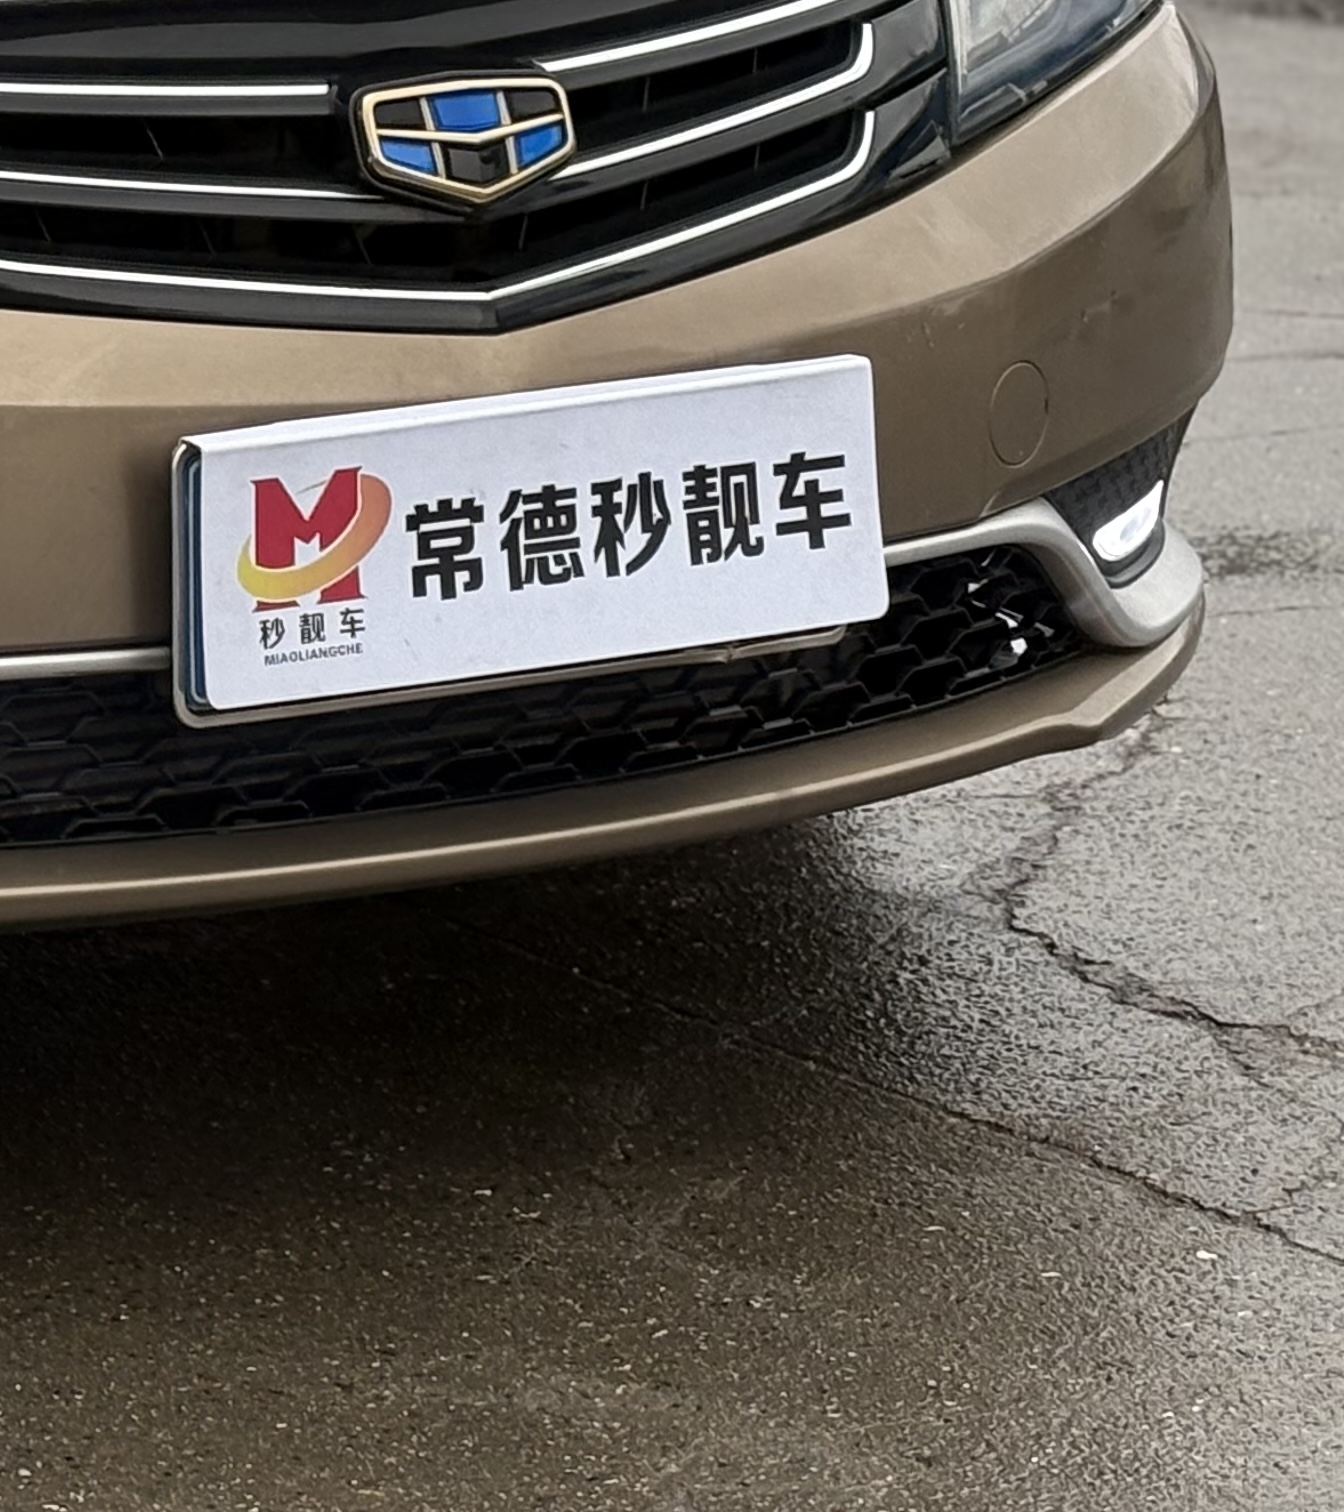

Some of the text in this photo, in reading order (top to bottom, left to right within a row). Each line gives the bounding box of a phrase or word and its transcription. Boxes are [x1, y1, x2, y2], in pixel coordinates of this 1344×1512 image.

[405, 451, 852, 600] 常德秒靓车
[259, 608, 366, 650] 秒靓车
[264, 643, 364, 666] MIAOLIANGCHE
